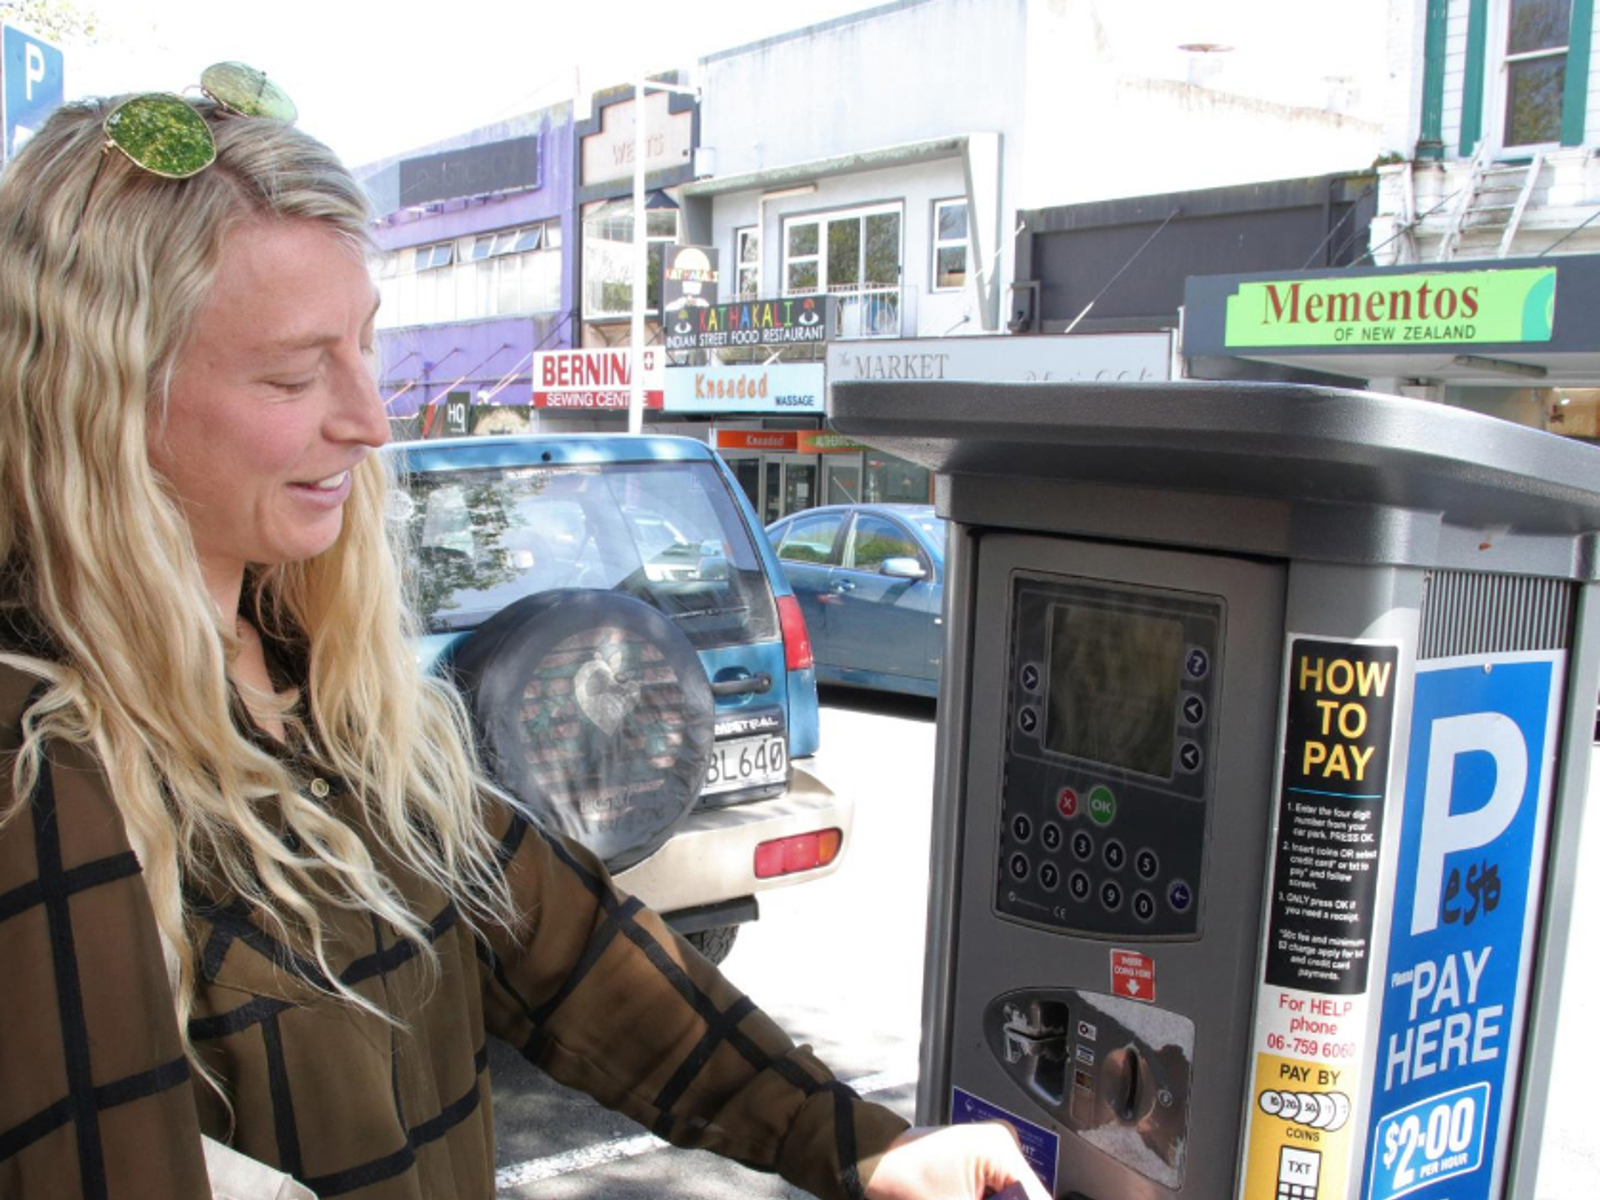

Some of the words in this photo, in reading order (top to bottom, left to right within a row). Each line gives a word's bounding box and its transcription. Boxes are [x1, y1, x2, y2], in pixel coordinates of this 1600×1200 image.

[25, 42, 45, 100] P
[613, 134, 663, 165] WETS
[1261, 280, 1479, 326] Mementos
[698, 301, 794, 332] KATHAKALI
[667, 334, 697, 348] INDIAN
[700, 332, 728, 345] STREET
[731, 329, 760, 344] FOOD
[763, 325, 825, 342] RESTAURANT
[1334, 327, 1354, 342] OF
[1361, 326, 1396, 342] NEW
[1403, 325, 1477, 341] ZEALAND
[854, 353, 949, 379] MARKET
[694, 372, 769, 399] Kneaded
[546, 392, 593, 407] SEWING
[596, 391, 649, 407] CENTE
[775, 395, 815, 406] MASSAGE
[1299, 656, 1391, 697] HOW
[1316, 699, 1368, 739] TO
[1303, 740, 1375, 781] PAY
[1091, 799, 1113, 814] OK
[1295, 803, 1317, 813] Enter
[1319, 806, 1333, 816] the
[1334, 807, 1351, 817] four
[1352, 810, 1371, 821] digit
[1327, 819, 1346, 829] from
[1347, 823, 1367, 832] your
[1410, 711, 1528, 936] P
[1330, 831, 1359, 842] PRESS
[1290, 856, 1314, 865] credit
[1292, 843, 1315, 854] Insert
[1316, 846, 1338, 857] coins
[1340, 848, 1354, 858] OR
[1309, 869, 1325, 879] and
[1286, 892, 1310, 904] ONLY
[1310, 898, 1333, 908] press
[1334, 900, 1349, 910] OK
[1284, 906, 1300, 916] you
[1301, 907, 1323, 919] need
[1323, 911, 1329, 919] a
[1288, 943, 1316, 955] charge
[1311, 935, 1328, 945] and
[1290, 955, 1306, 964] and
[1307, 957, 1331, 968] credit
[1332, 961, 1351, 970] card
[1409, 946, 1492, 1021] PAY
[1279, 993, 1306, 1012] For
[1310, 998, 1353, 1017] HELP
[1289, 1015, 1338, 1036] phone
[1267, 1032, 1318, 1057] 06-759
[1384, 1004, 1503, 1092] HERE
[1279, 1063, 1311, 1083] PAY
[1318, 1069, 1341, 1086] BY
[1286, 1127, 1320, 1142] COINS
[1288, 1160, 1312, 1175] TXT
[1419, 1160, 1440, 1179] PER
[1440, 1153, 1469, 1171] HOUR
